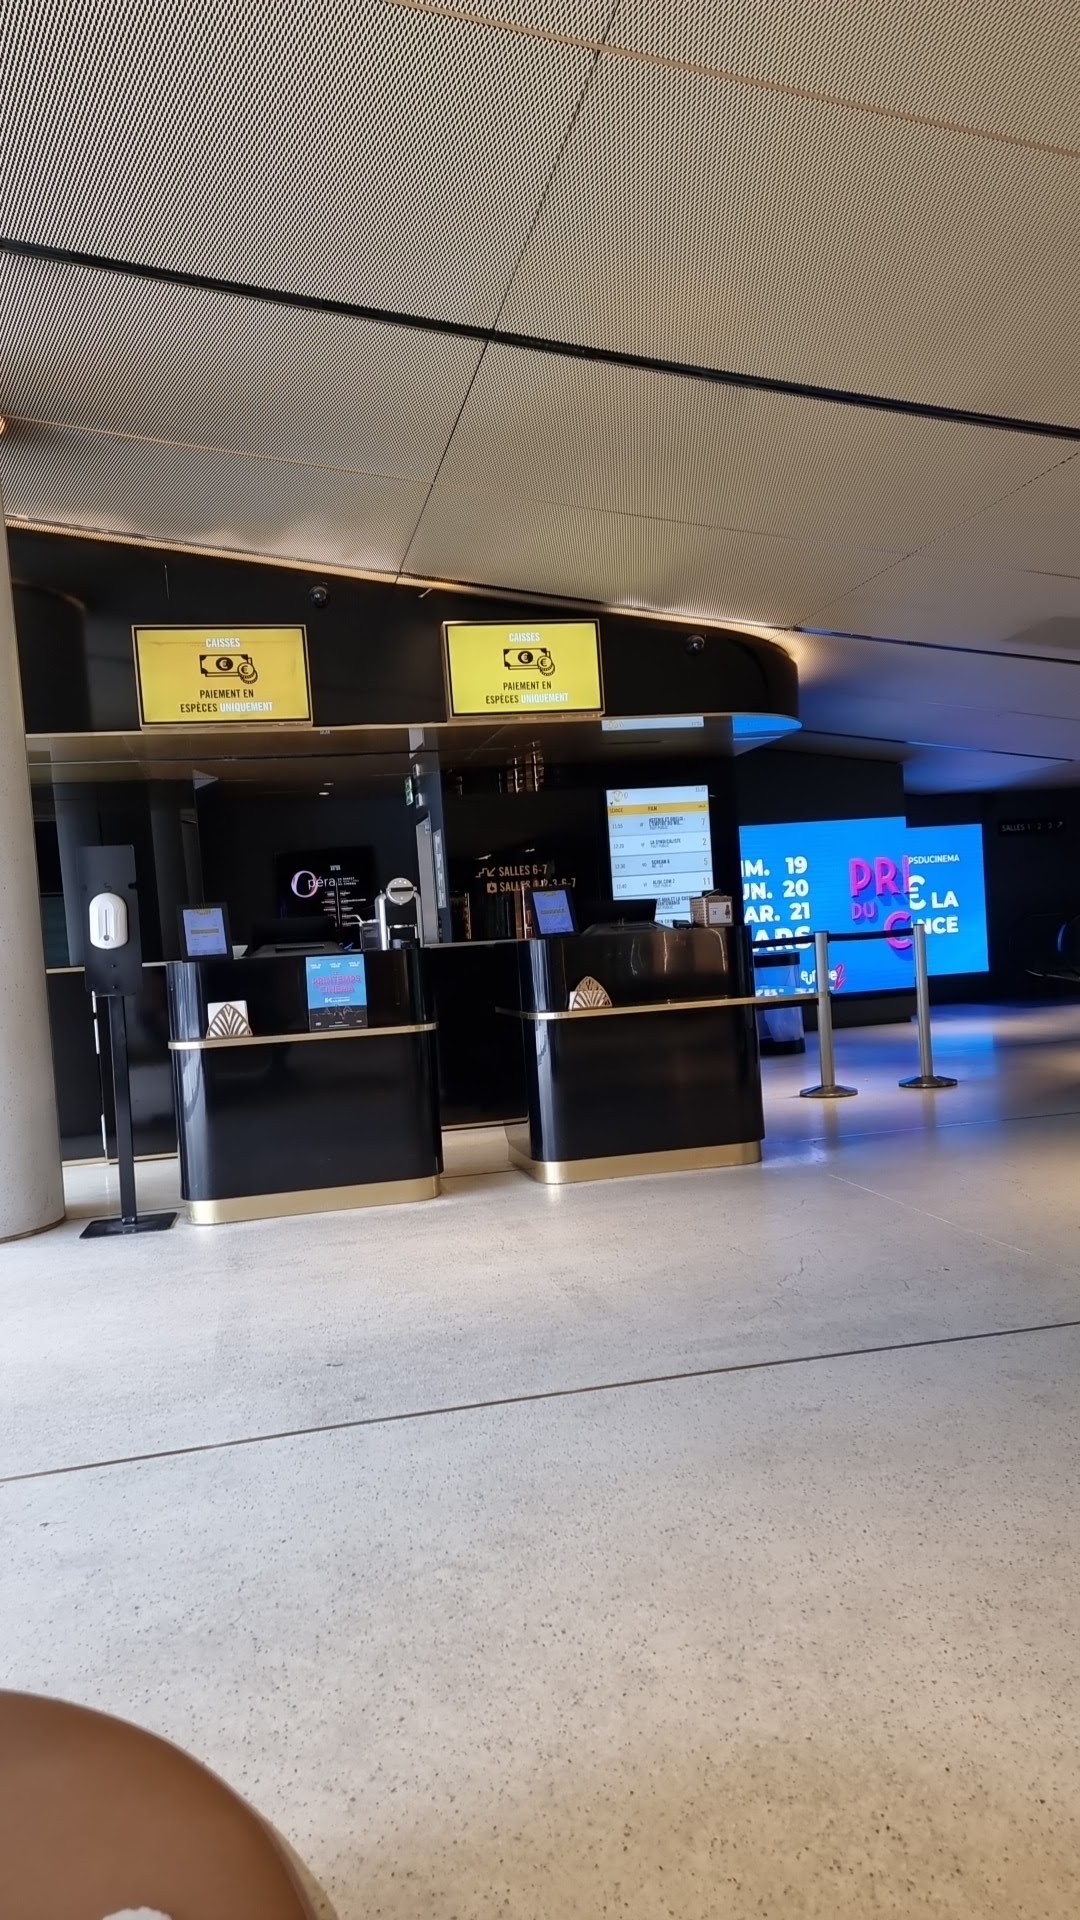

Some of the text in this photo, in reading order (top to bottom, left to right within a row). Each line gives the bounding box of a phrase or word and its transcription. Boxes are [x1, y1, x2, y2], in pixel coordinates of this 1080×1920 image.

[205, 638, 241, 648] CAISSES
[509, 632, 540, 643] CAISSES
[503, 681, 552, 690] PAIEMENT EN
[199, 688, 254, 699] PAIEMENT EN
[485, 693, 568, 704] ESPÈCES UNIQUEMENT
[180, 702, 273, 713] ESPÈCES UNIQUEMENT
[1002, 824, 1025, 832] SALLES
[702, 838, 707, 846] 2
[703, 857, 709, 866] 5
[784, 856, 808, 874] 19
[499, 864, 548, 877] SALLES 6-7
[291, 870, 336, 898] Opéra
[703, 877, 711, 886] 11
[782, 879, 809, 898] 20
[931, 891, 959, 908] LA
[789, 902, 811, 920] 21
[852, 902, 876, 920] DU
